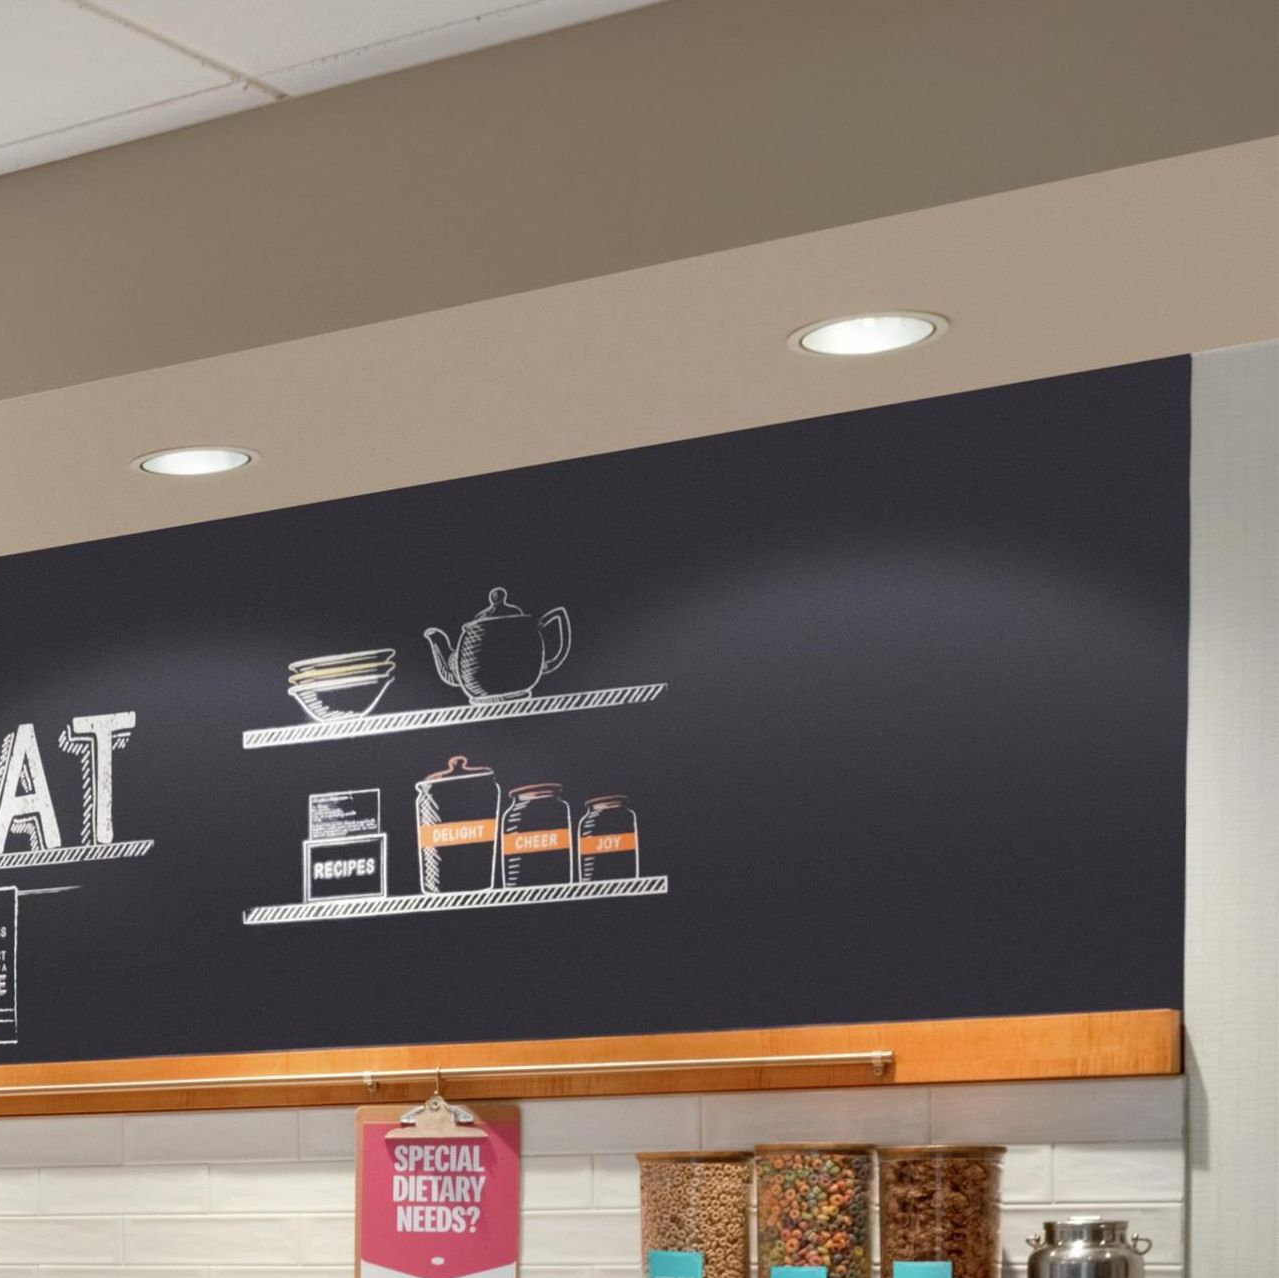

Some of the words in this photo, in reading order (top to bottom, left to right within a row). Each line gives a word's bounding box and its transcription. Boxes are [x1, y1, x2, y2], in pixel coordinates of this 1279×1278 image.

[432, 825, 485, 842] DELIGHT
[514, 834, 559, 851] CHEER
[596, 836, 623, 851] JOY
[313, 858, 376, 880] RECIPES
[2, 963, 7, 972] A
[394, 1145, 484, 1172] SPECIAL
[393, 1175, 486, 1202] DIETARY
[396, 1205, 481, 1233] NEEDS?
